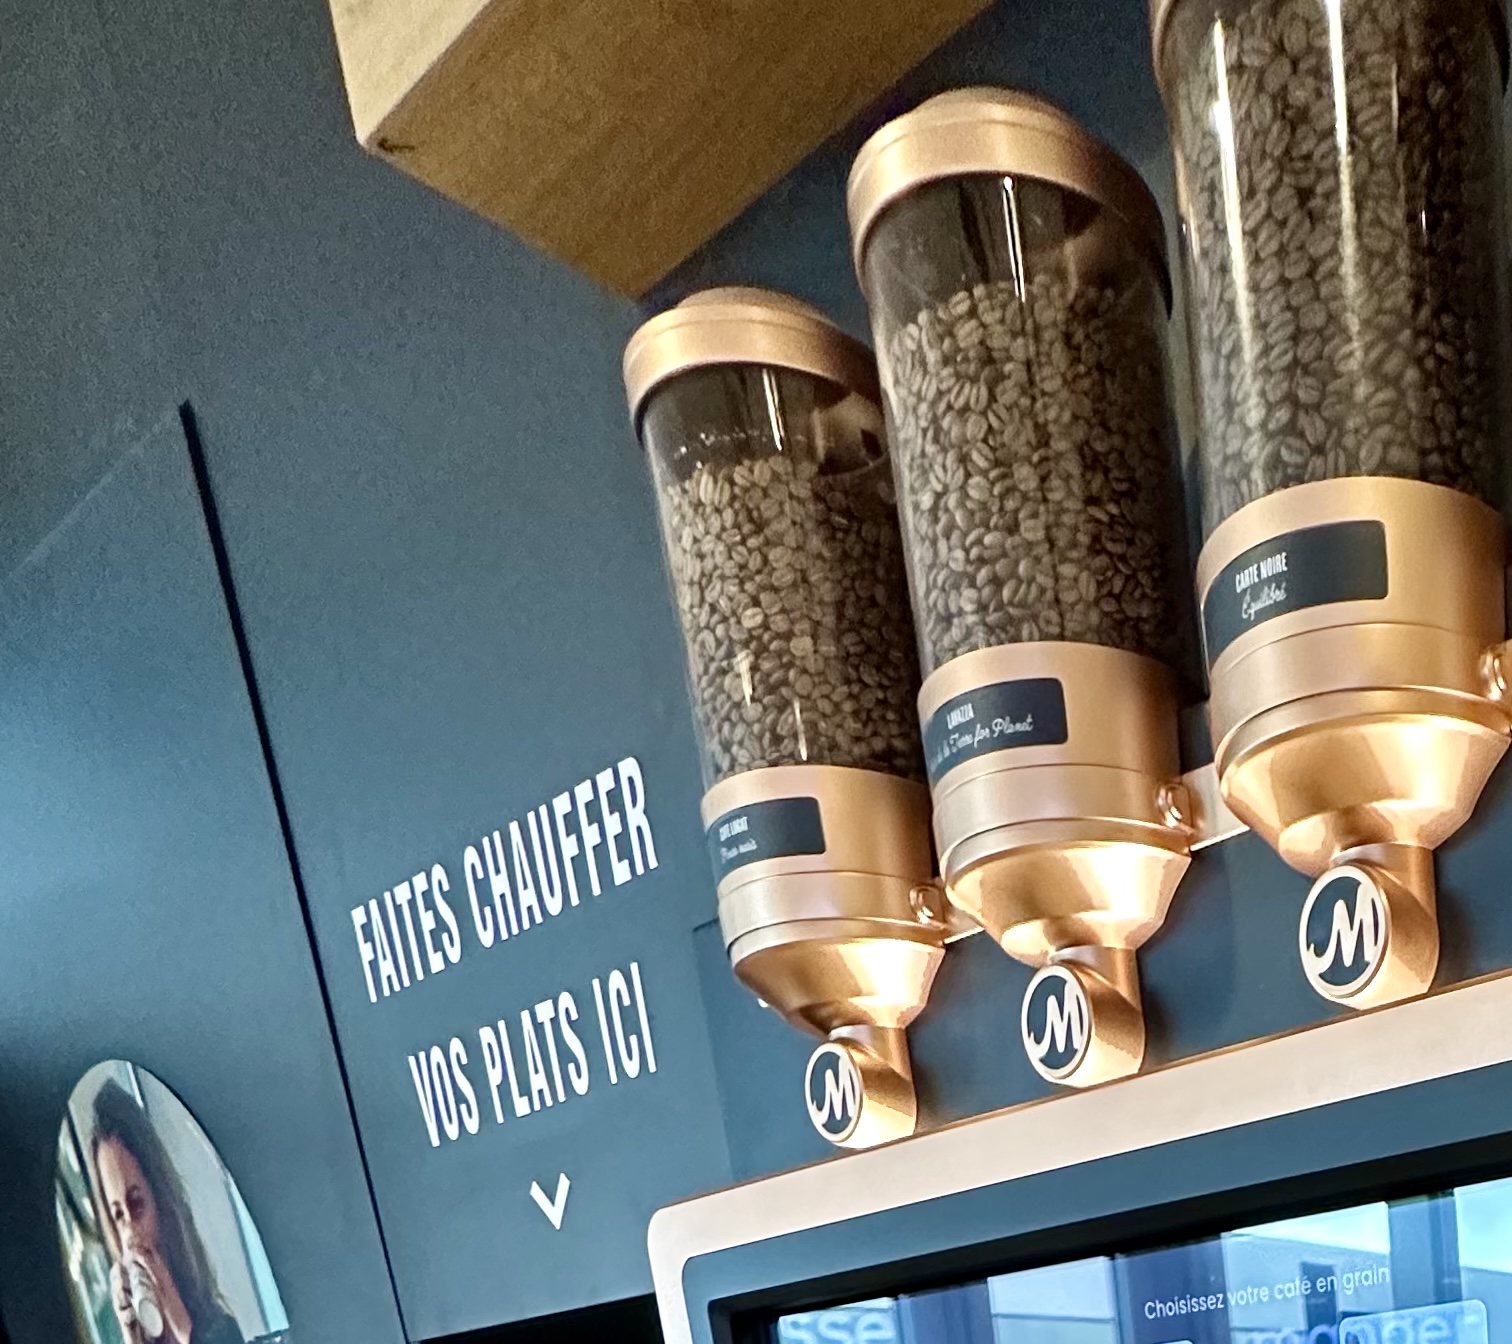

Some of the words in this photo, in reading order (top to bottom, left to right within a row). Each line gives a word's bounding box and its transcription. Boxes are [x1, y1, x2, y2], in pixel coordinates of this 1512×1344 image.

[1235, 563, 1260, 593] CARTE
[1260, 552, 1288, 580] NOIRE
[992, 713, 1034, 738] Planet
[351, 863, 462, 1003] FAITES
[463, 756, 659, 949] CHAUFFER
[408, 1036, 480, 1148] VOS
[478, 991, 590, 1125] PLATS
[591, 960, 658, 1085] ICI
[1144, 1293, 1225, 1320] Choisissez
[1226, 1285, 1269, 1306] votre
[1273, 1275, 1312, 1300] café
[1315, 1274, 1338, 1293] en
[1342, 1264, 1390, 1295] grain
